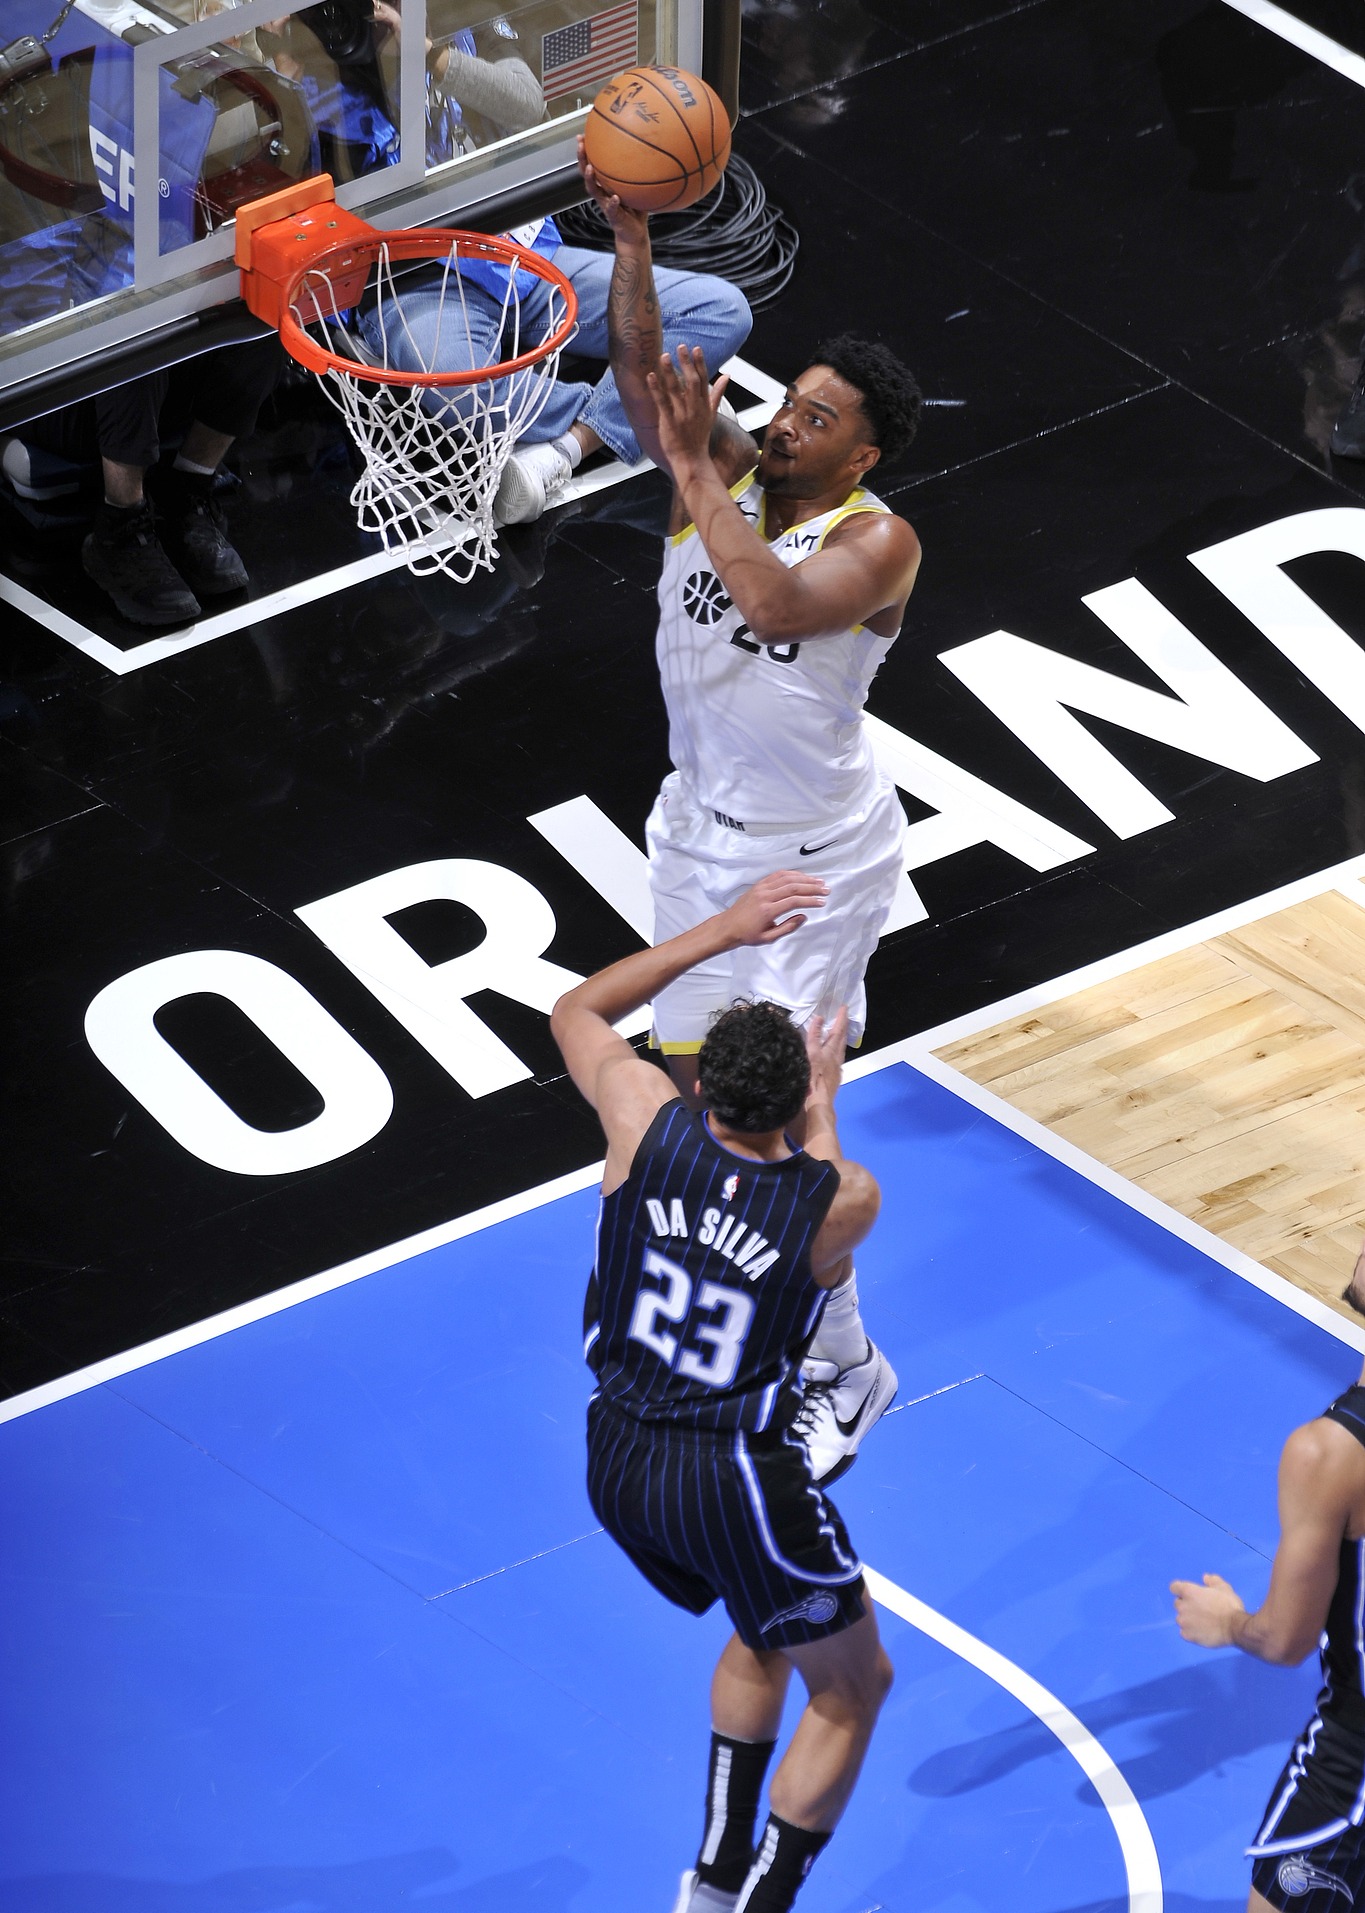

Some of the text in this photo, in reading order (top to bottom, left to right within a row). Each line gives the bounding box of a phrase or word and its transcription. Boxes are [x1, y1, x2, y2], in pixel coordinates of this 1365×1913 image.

[646, 1198, 781, 1282] DA SILVA
[629, 1248, 756, 1389] 23
